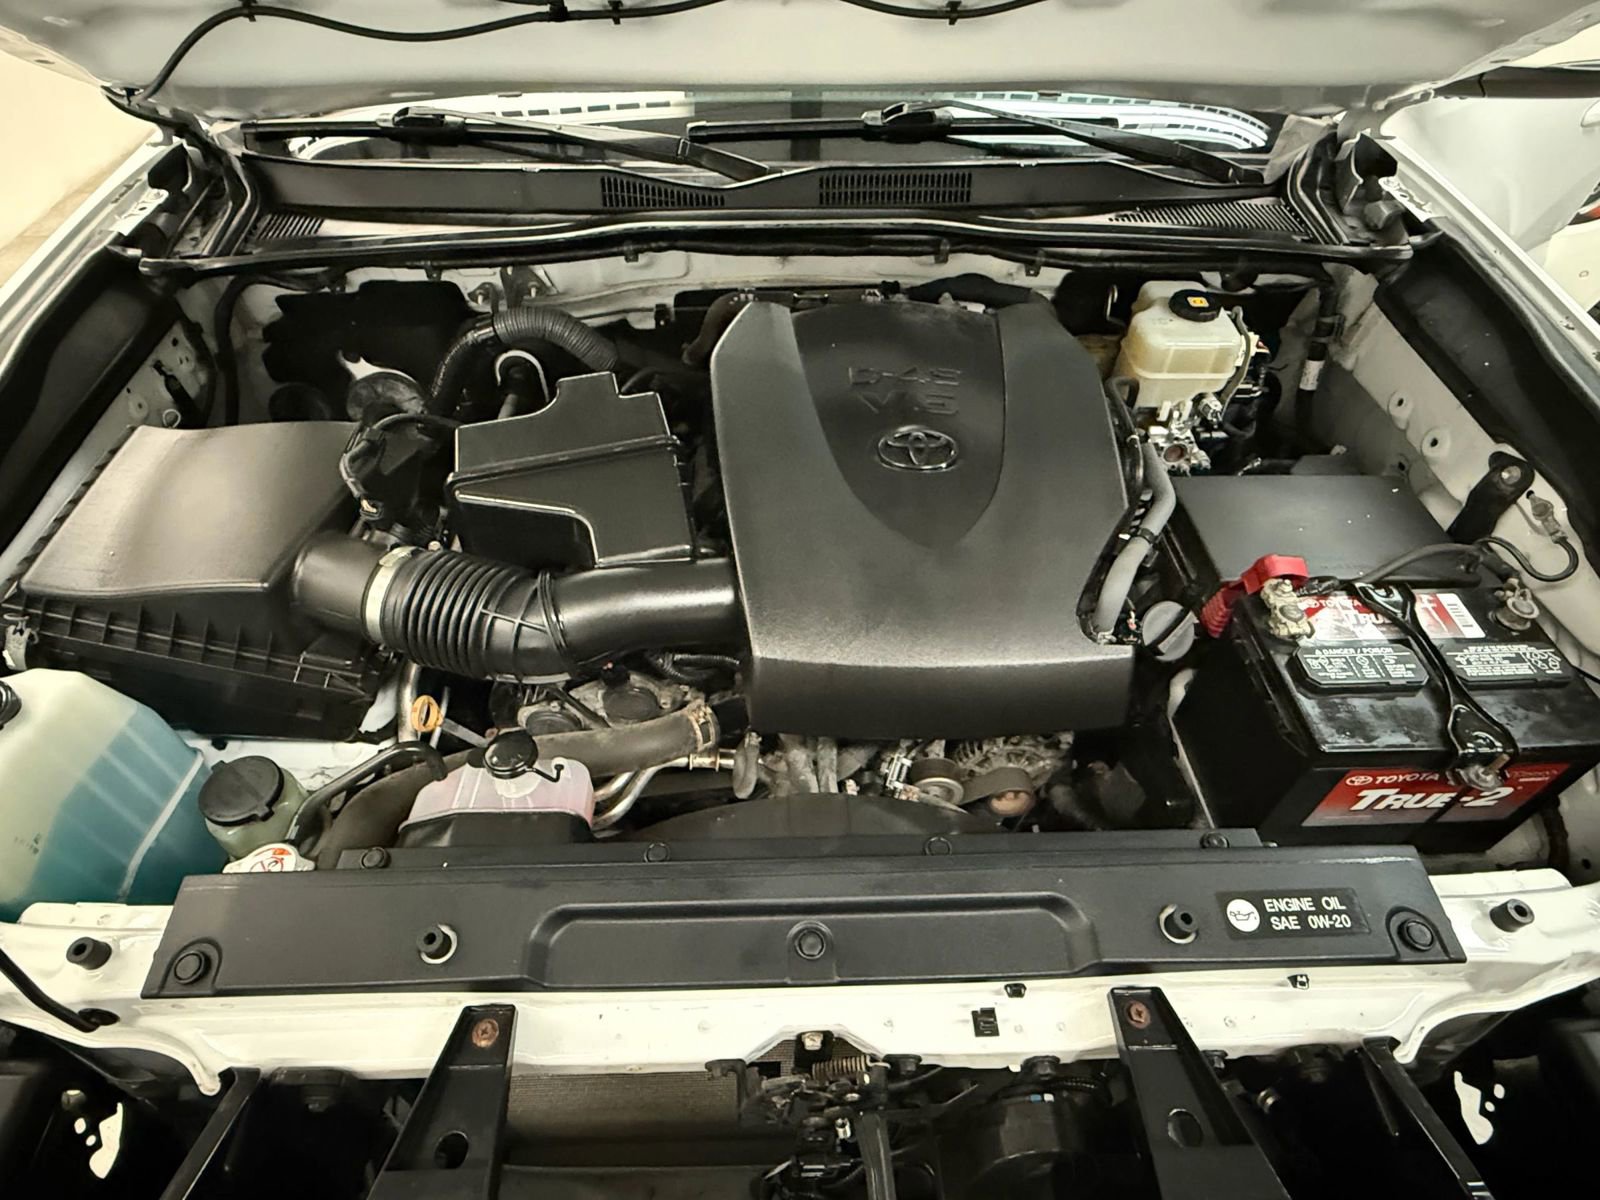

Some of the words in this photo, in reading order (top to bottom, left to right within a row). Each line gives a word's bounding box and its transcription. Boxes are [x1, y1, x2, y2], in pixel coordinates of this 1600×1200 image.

[1375, 772, 1440, 785] TOYOTA
[1263, 897, 1316, 913] ENGINE
[1321, 895, 1347, 910] OIL
[1270, 915, 1301, 931] SAE
[1307, 913, 1352, 930] 0W-20
